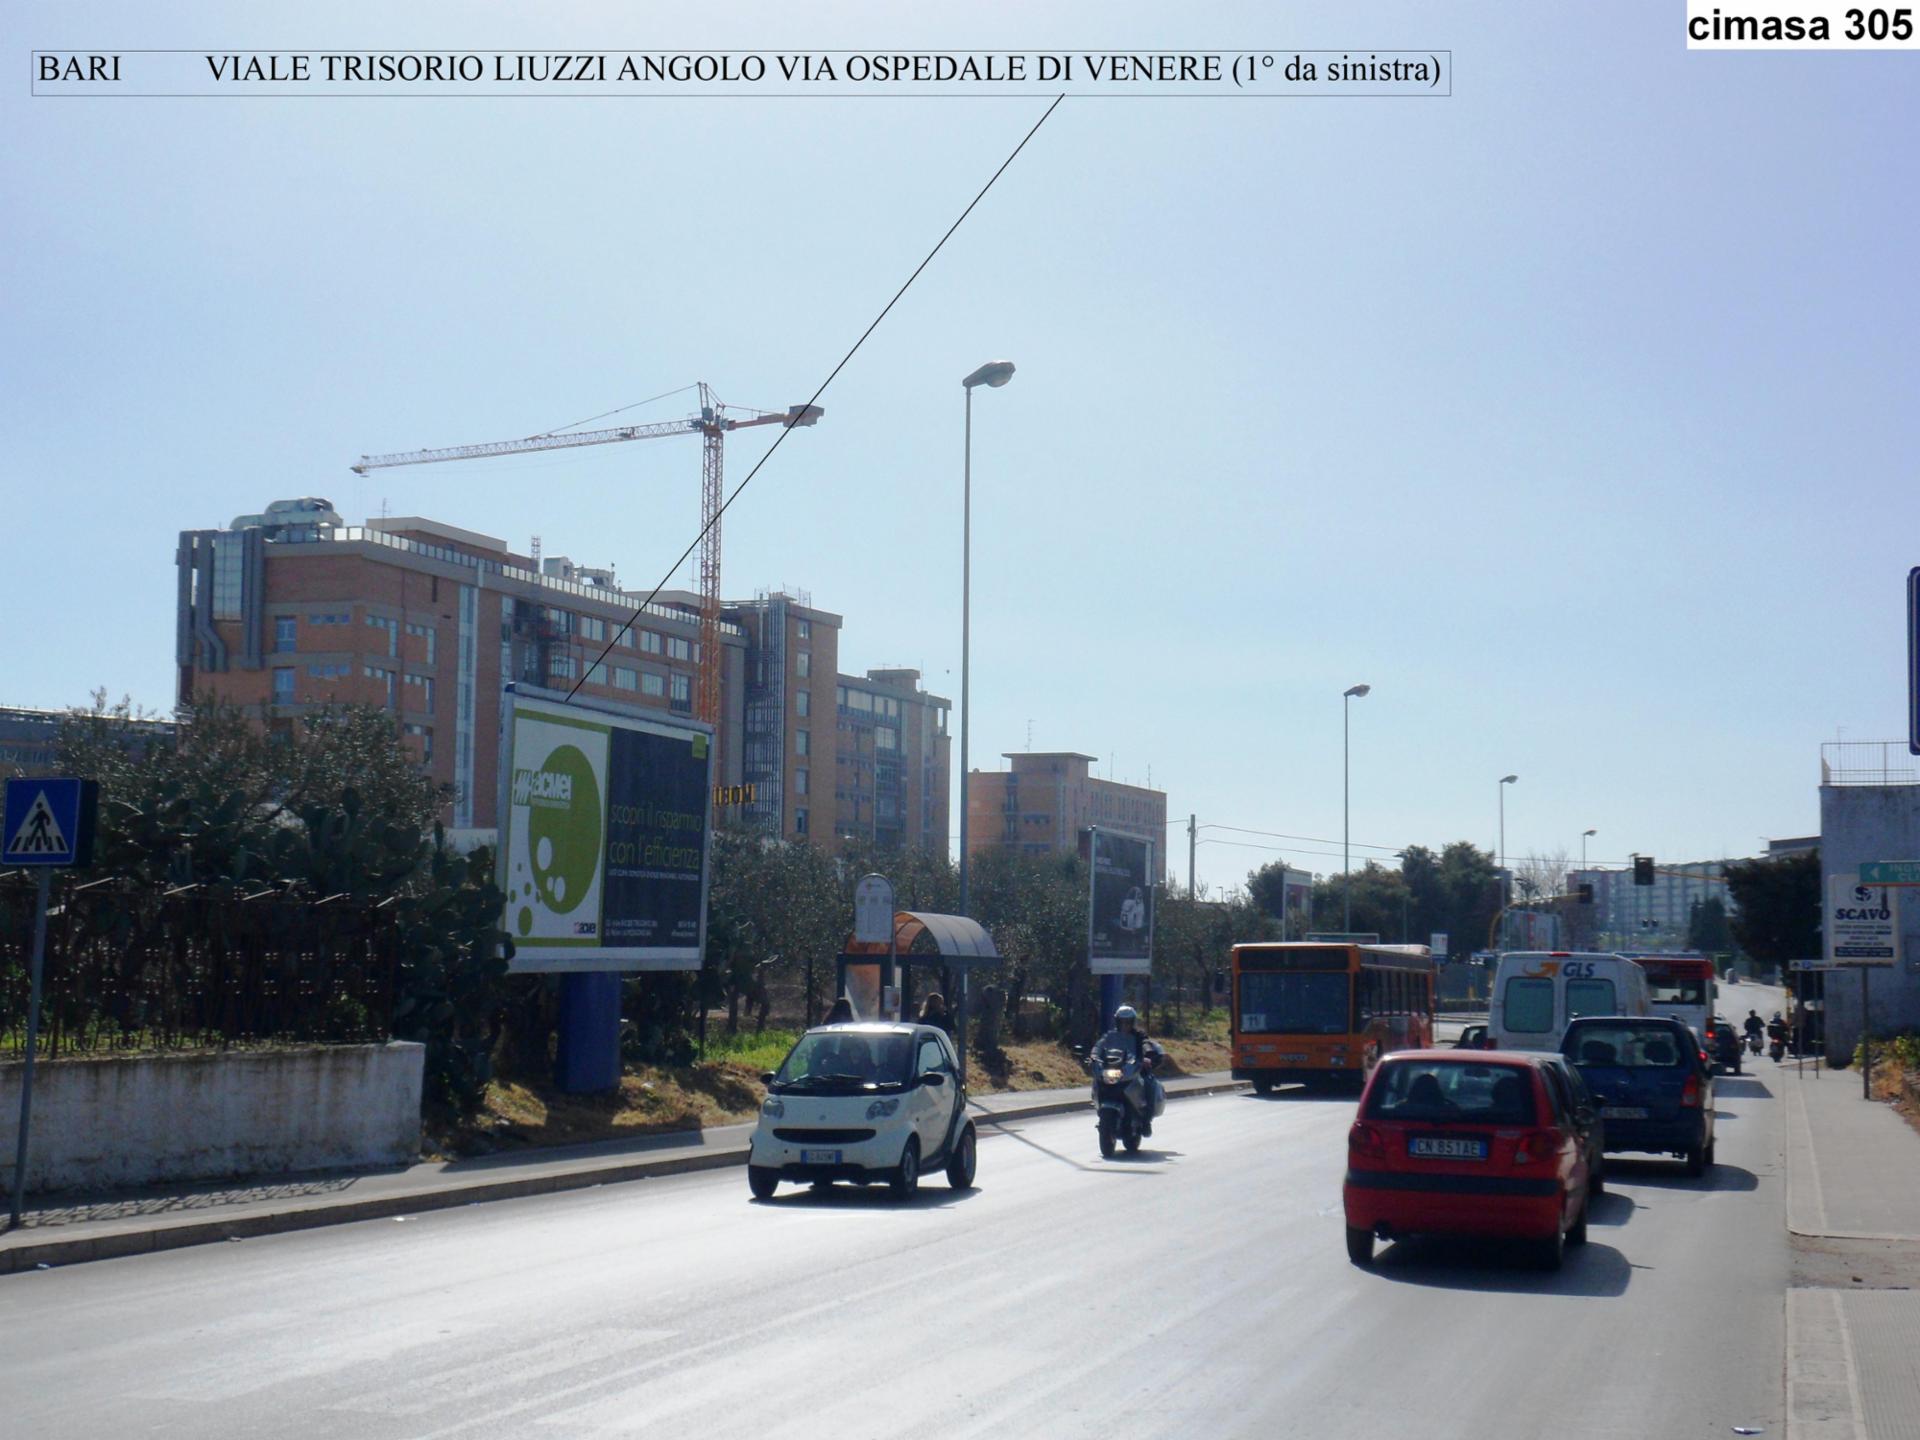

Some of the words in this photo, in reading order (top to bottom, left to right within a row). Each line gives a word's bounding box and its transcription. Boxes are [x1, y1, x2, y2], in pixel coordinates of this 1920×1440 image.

[609, 841, 635, 865] con
[1835, 908, 1891, 920] SCAVO
[1562, 962, 1595, 978] GLS
